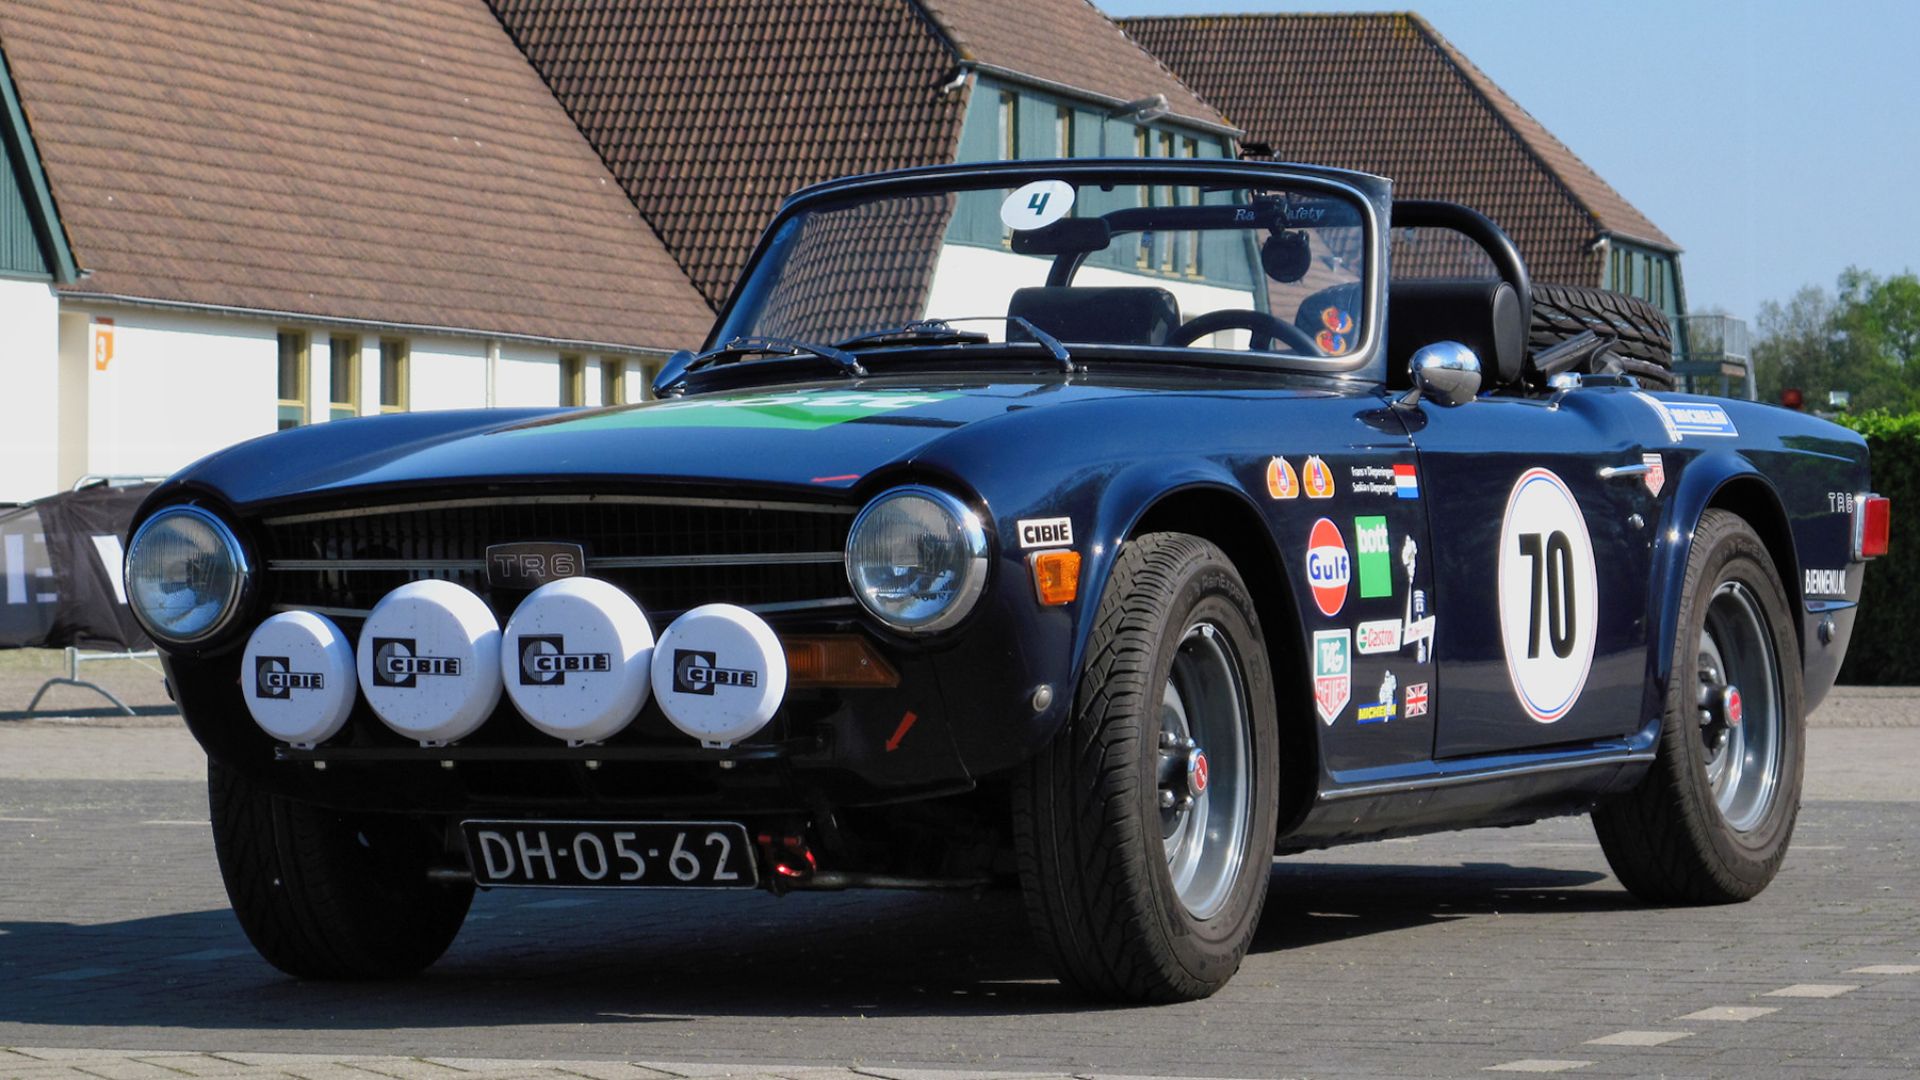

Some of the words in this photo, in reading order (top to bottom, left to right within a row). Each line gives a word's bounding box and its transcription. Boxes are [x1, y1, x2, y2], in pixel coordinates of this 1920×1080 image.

[1027, 193, 1051, 216] 4
[97, 335, 107, 362] 3
[1828, 492, 1854, 513] TR6
[494, 553, 575, 577] TR6
[1309, 553, 1347, 580] Gulf
[1518, 530, 1576, 658] 70
[1368, 627, 1396, 647] Castrol
[478, 831, 738, 881] DH-05-62
